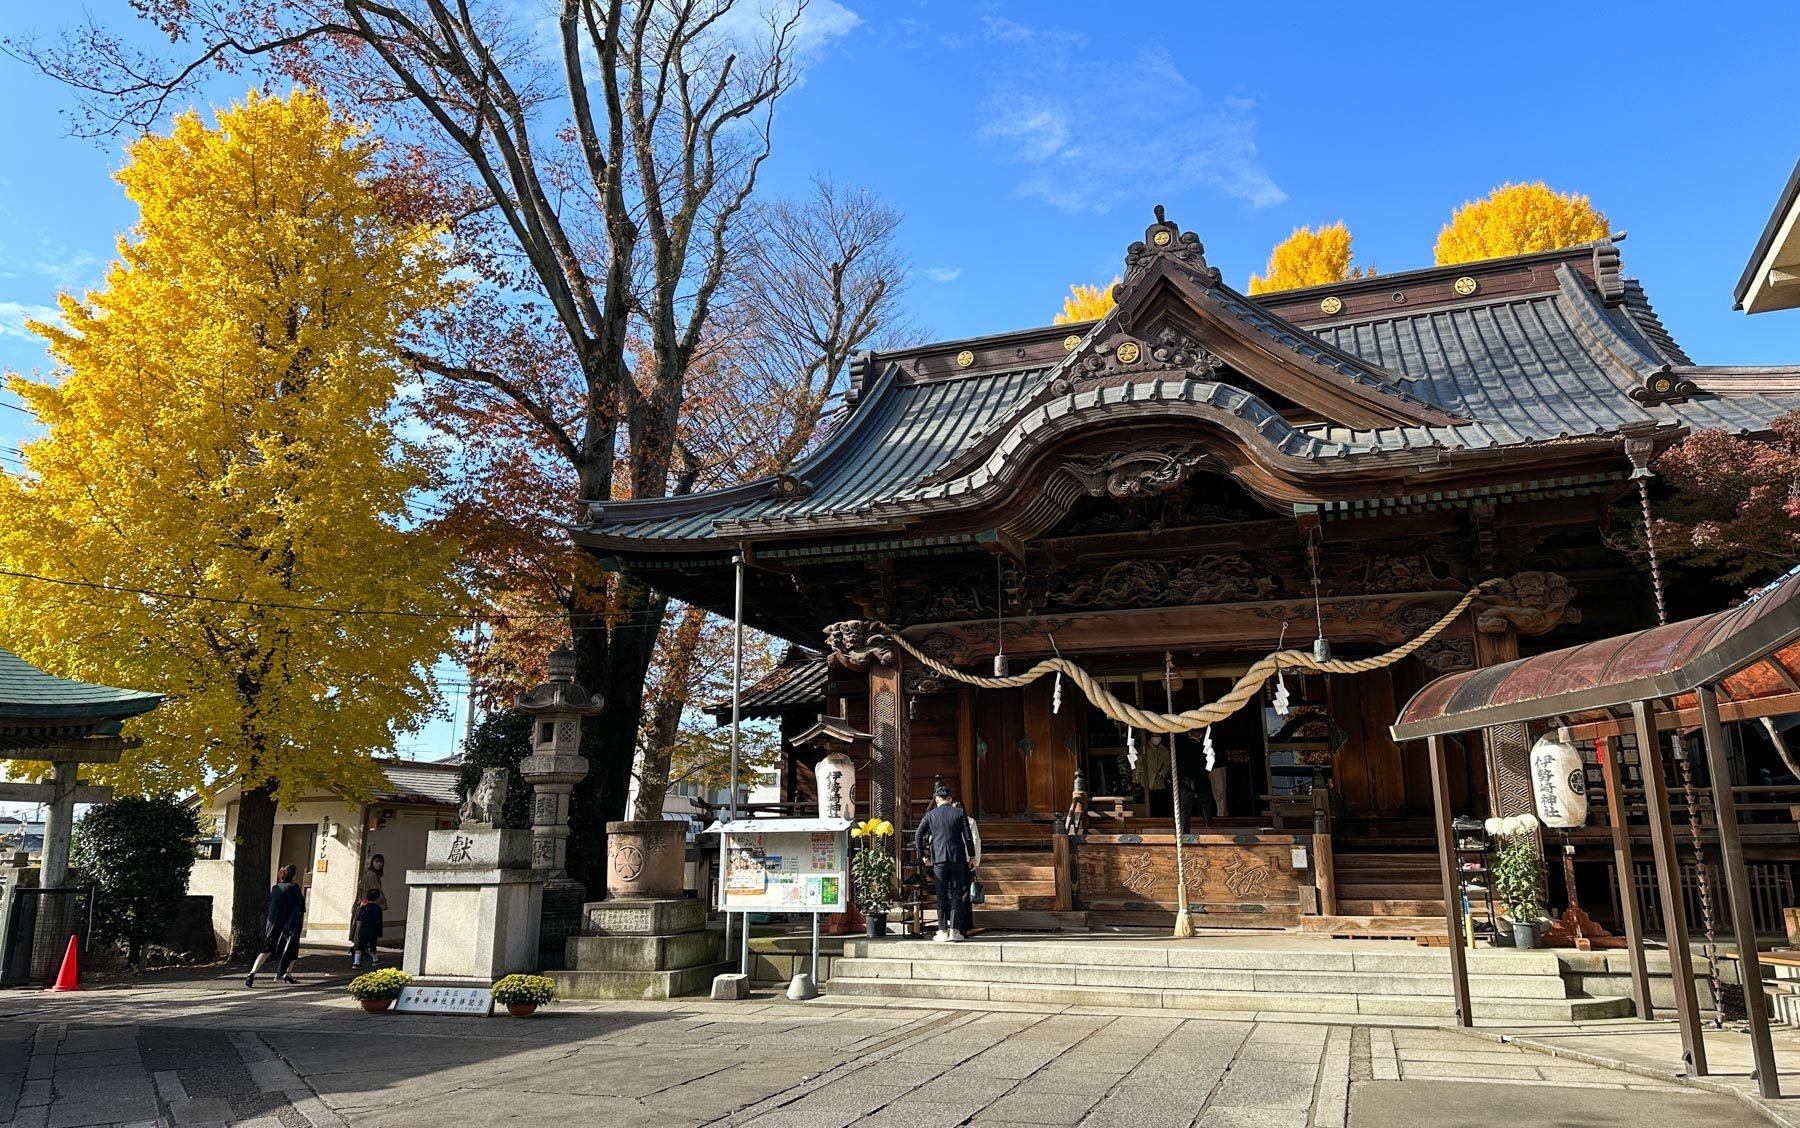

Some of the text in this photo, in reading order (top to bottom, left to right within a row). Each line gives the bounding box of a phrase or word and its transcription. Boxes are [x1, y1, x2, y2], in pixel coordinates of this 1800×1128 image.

[1535, 754, 1562, 818] 伊勢崎神社
[320, 815, 330, 859] 多目的トイレ
[435, 989, 459, 997] 七五三
